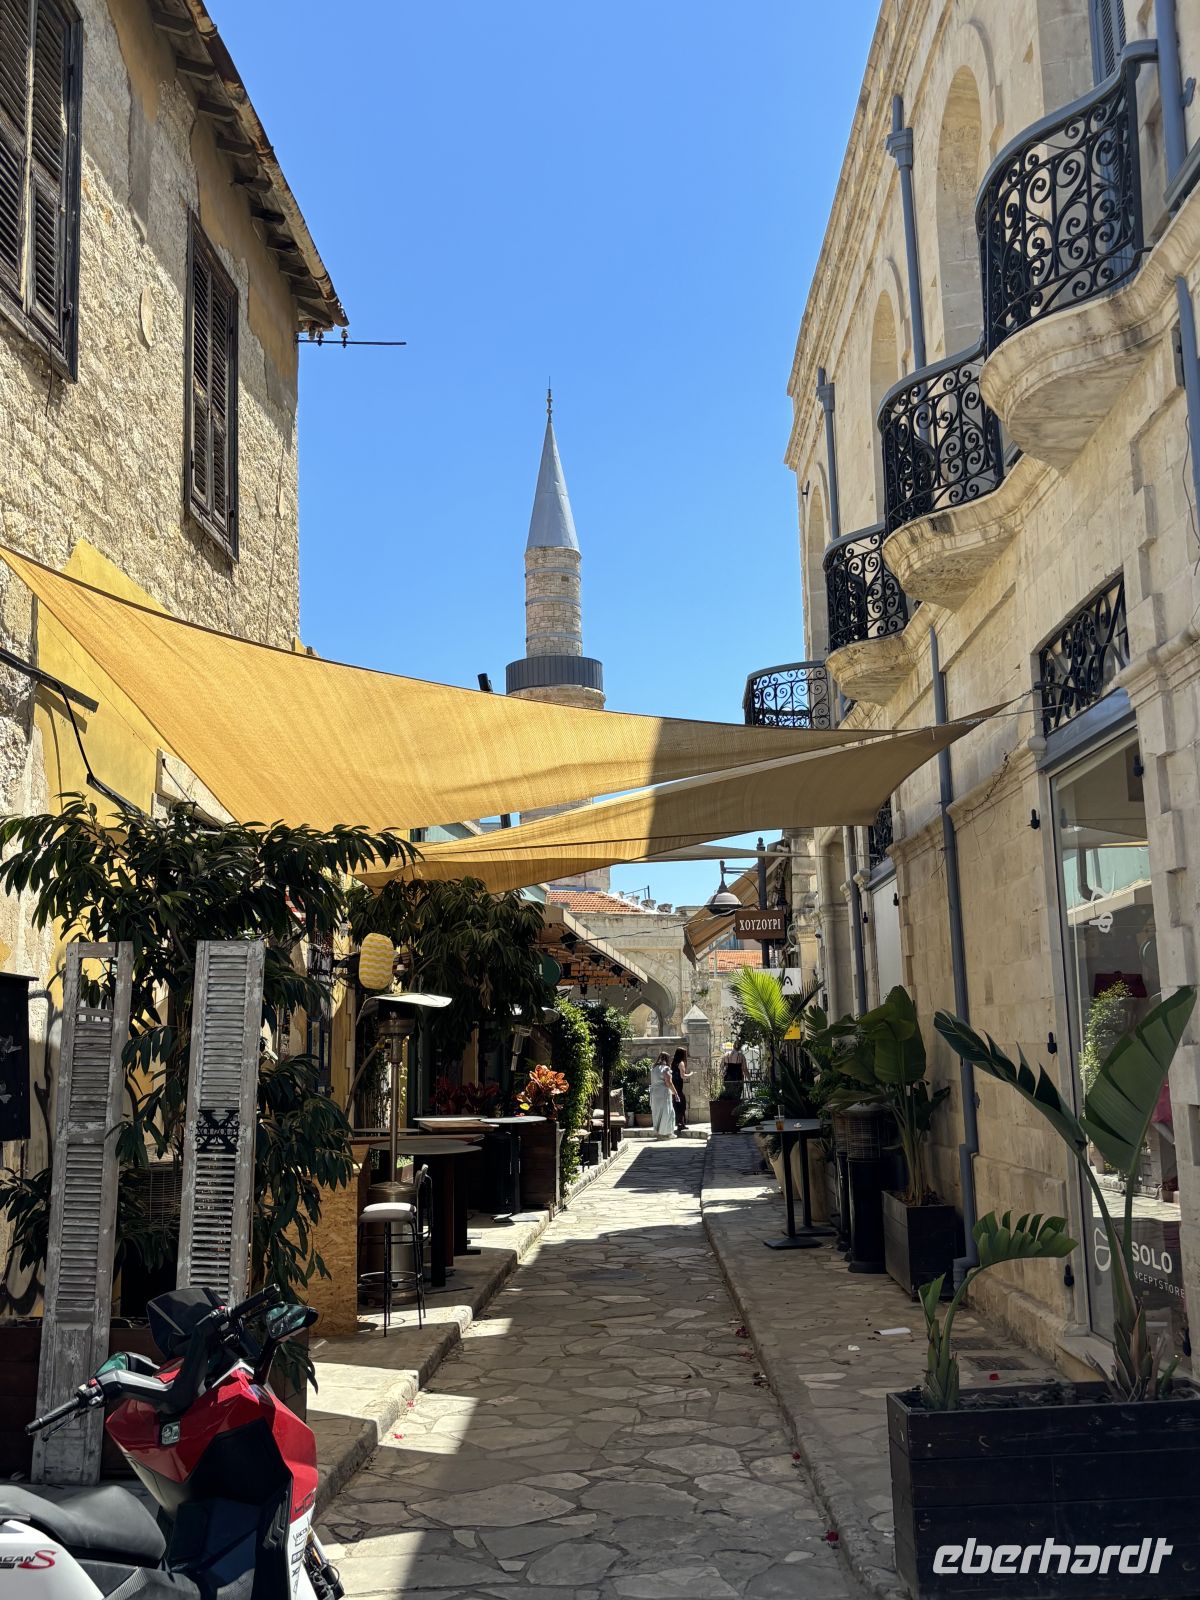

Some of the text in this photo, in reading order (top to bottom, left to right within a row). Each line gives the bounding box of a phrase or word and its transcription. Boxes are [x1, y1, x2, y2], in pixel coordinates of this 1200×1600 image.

[739, 918, 781, 931] ΧΟΥΖΟΥΡΙ
[1131, 1240, 1172, 1274] SOLO
[1133, 1270, 1185, 1299] NCEPTSTORE
